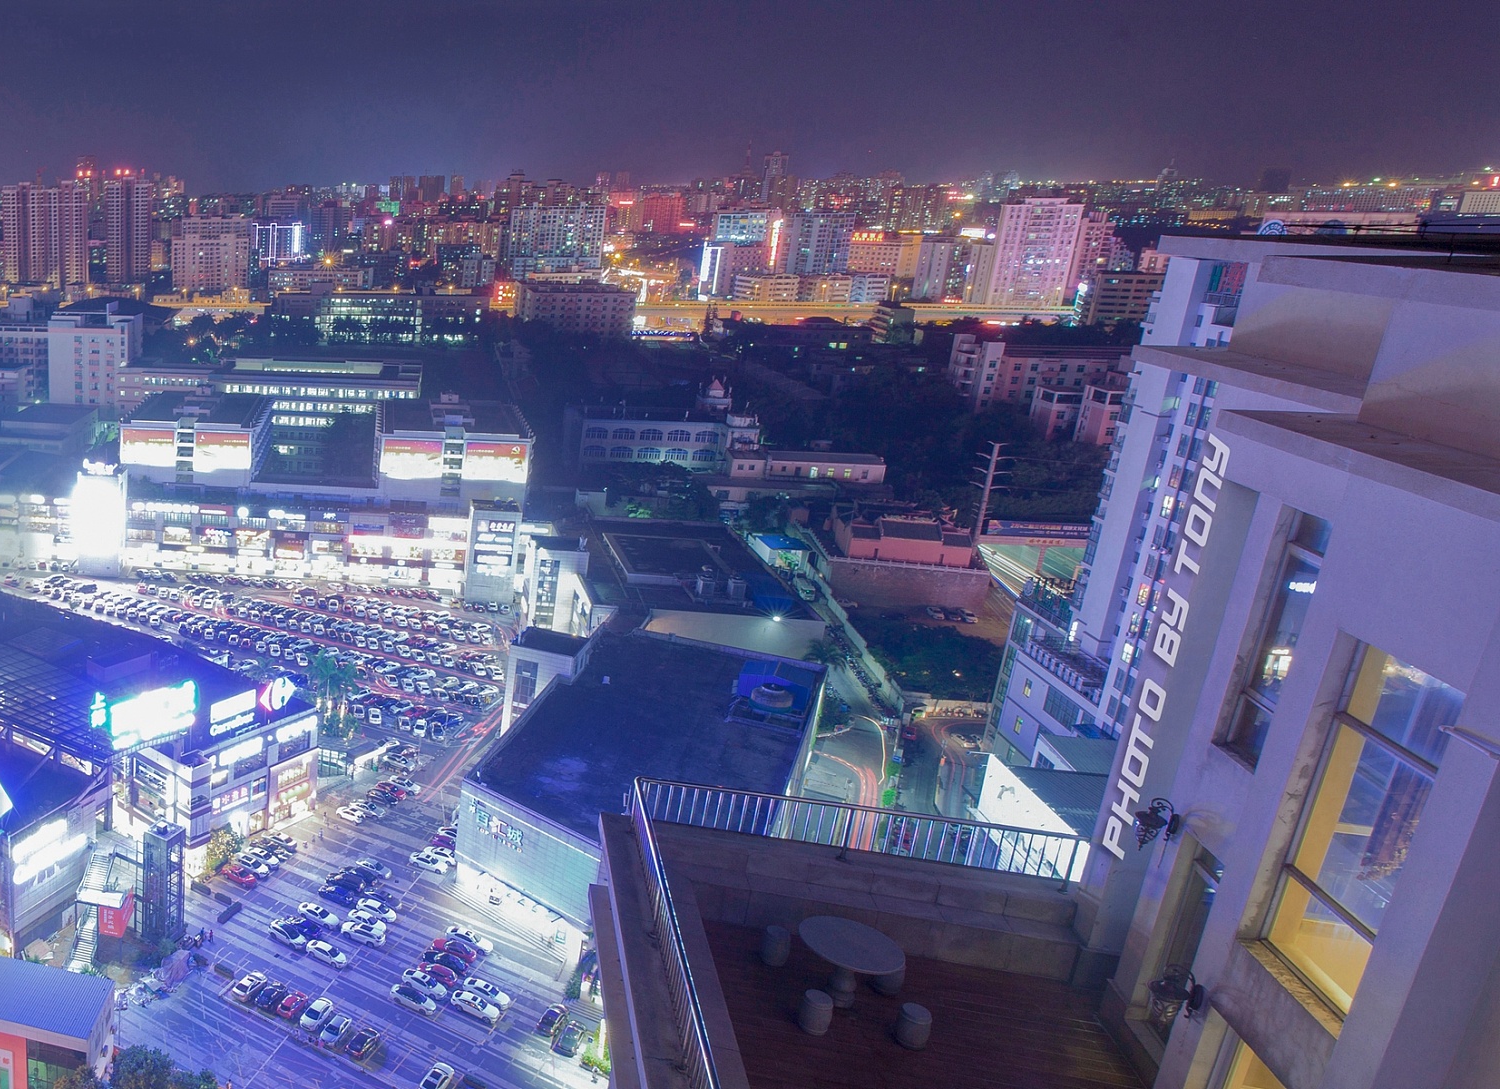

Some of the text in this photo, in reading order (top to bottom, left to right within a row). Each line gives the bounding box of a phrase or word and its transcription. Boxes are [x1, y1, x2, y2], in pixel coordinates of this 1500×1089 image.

[210, 712, 255, 736] Carrefour
[475, 809, 524, 846] 百汇城
